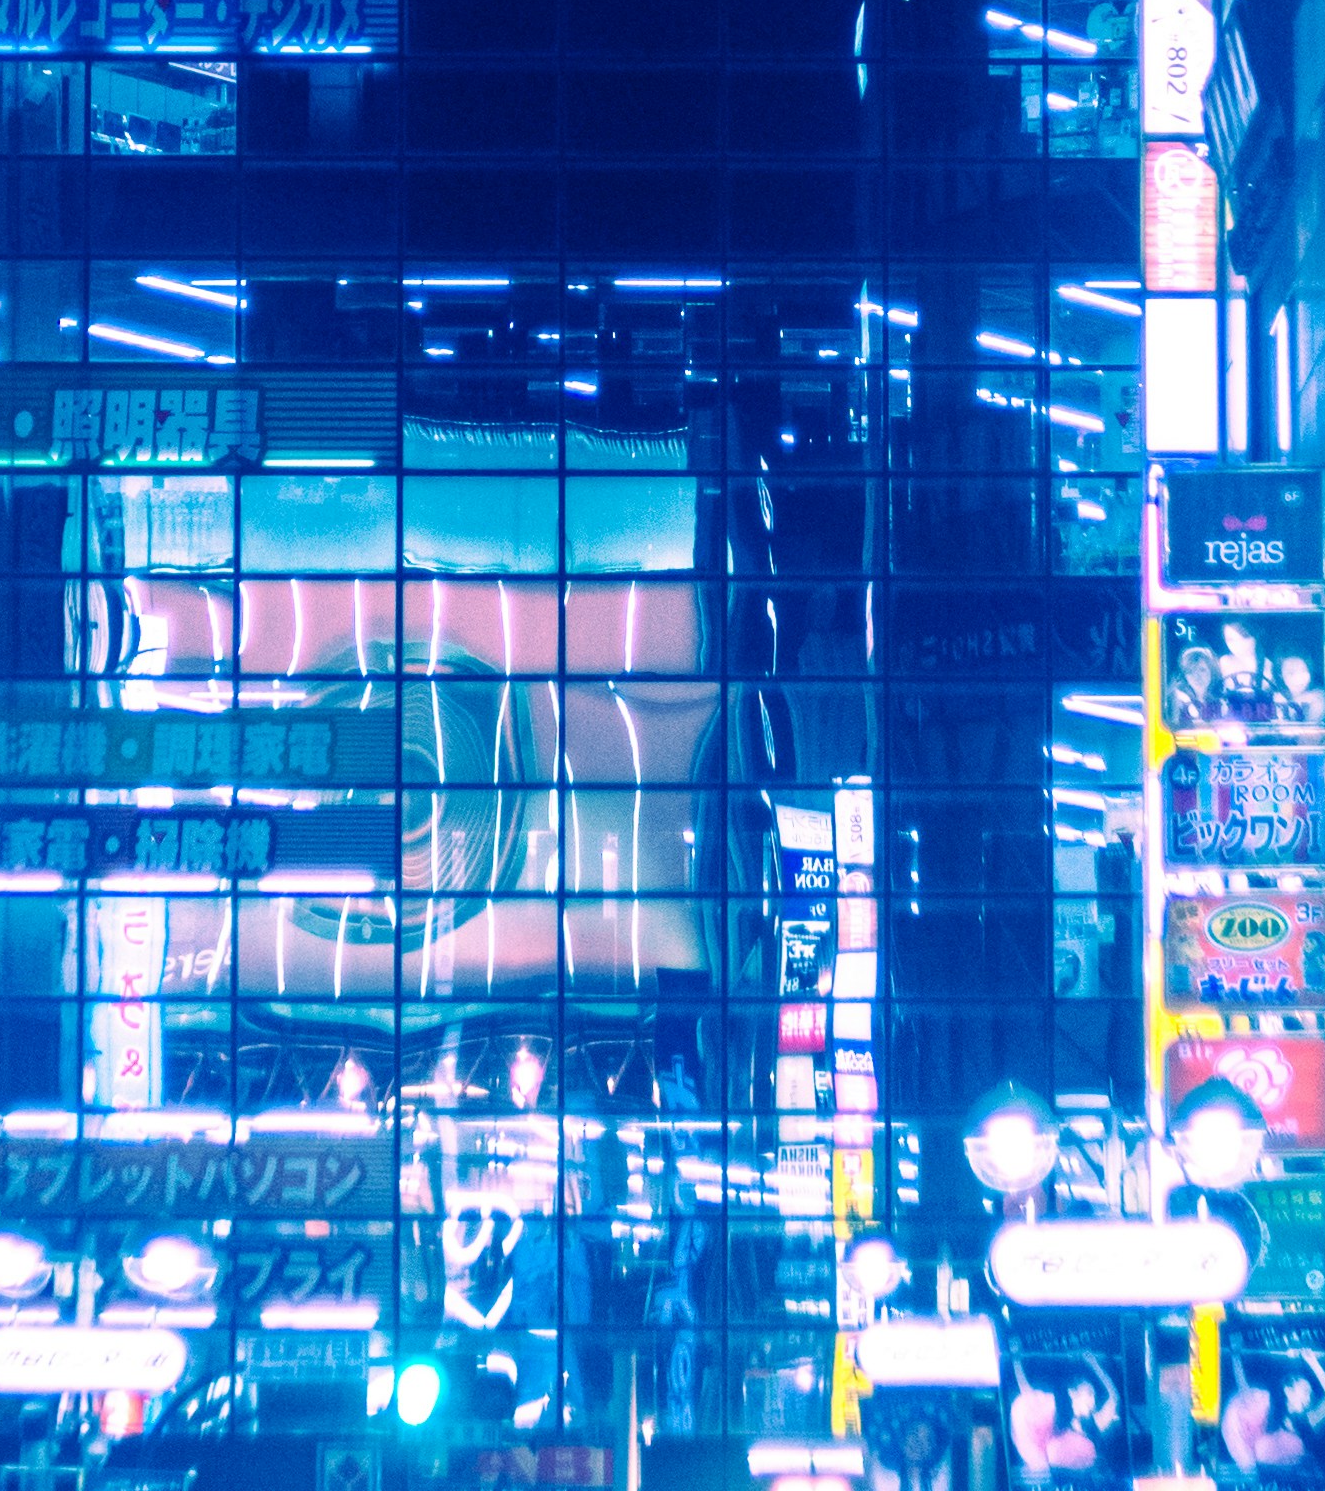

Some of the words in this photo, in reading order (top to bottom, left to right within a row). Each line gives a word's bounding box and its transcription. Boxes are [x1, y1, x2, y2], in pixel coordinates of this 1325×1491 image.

[1204, 532, 1285, 571] rejas
[1209, 759, 1303, 787] カラオケ
[1234, 782, 1317, 806] ROOM
[1296, 902, 1325, 924] 3F
